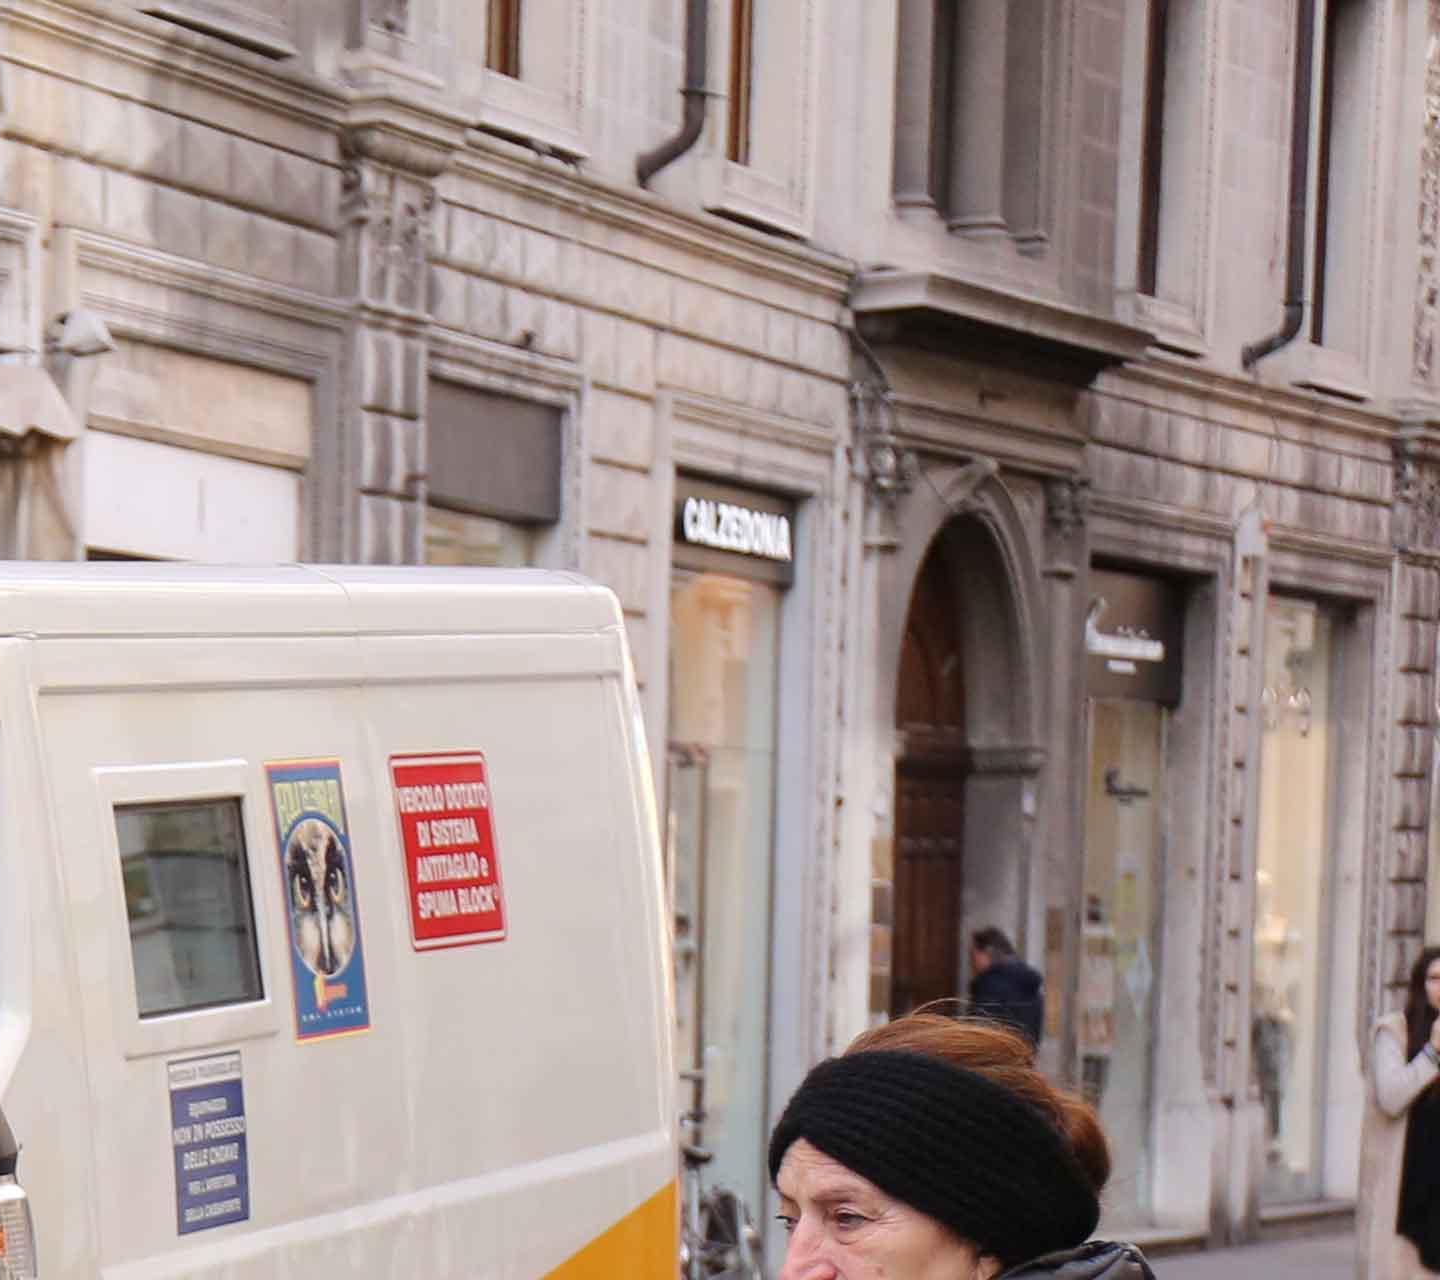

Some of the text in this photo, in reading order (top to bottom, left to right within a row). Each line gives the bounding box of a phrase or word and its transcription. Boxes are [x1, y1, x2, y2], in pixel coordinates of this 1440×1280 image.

[398, 783, 445, 814] VEICOLO
[415, 817, 481, 849] DI SISTEMA
